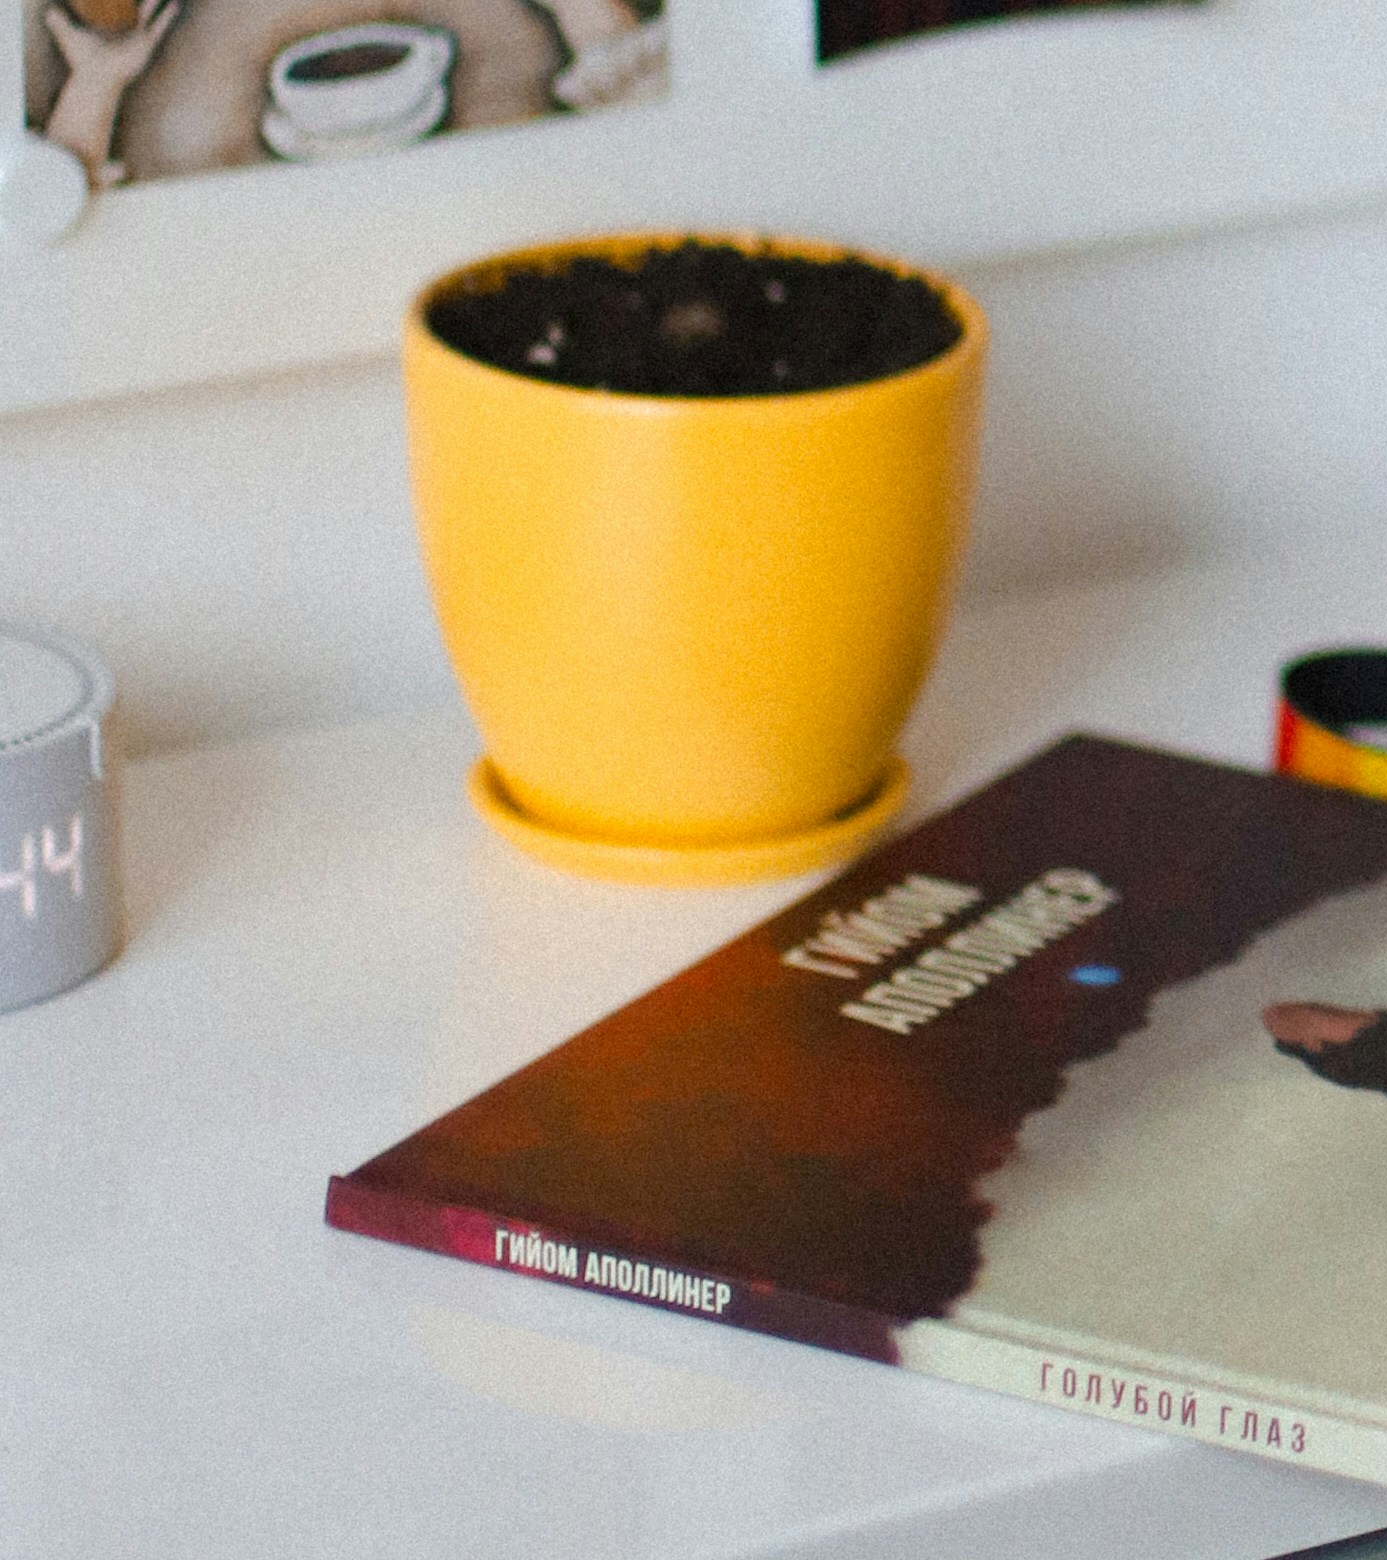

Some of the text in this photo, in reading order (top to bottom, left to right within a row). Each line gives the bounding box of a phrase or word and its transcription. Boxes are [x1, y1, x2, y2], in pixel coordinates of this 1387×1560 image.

[838, 866, 1122, 1036] АПОЛЛИНЕР
[494, 1227, 732, 1315] ГИЙОМ АПОЛЛИНЕР
[1040, 1361, 1307, 1454] ГОЛУБОЙ ГЛАЗ
